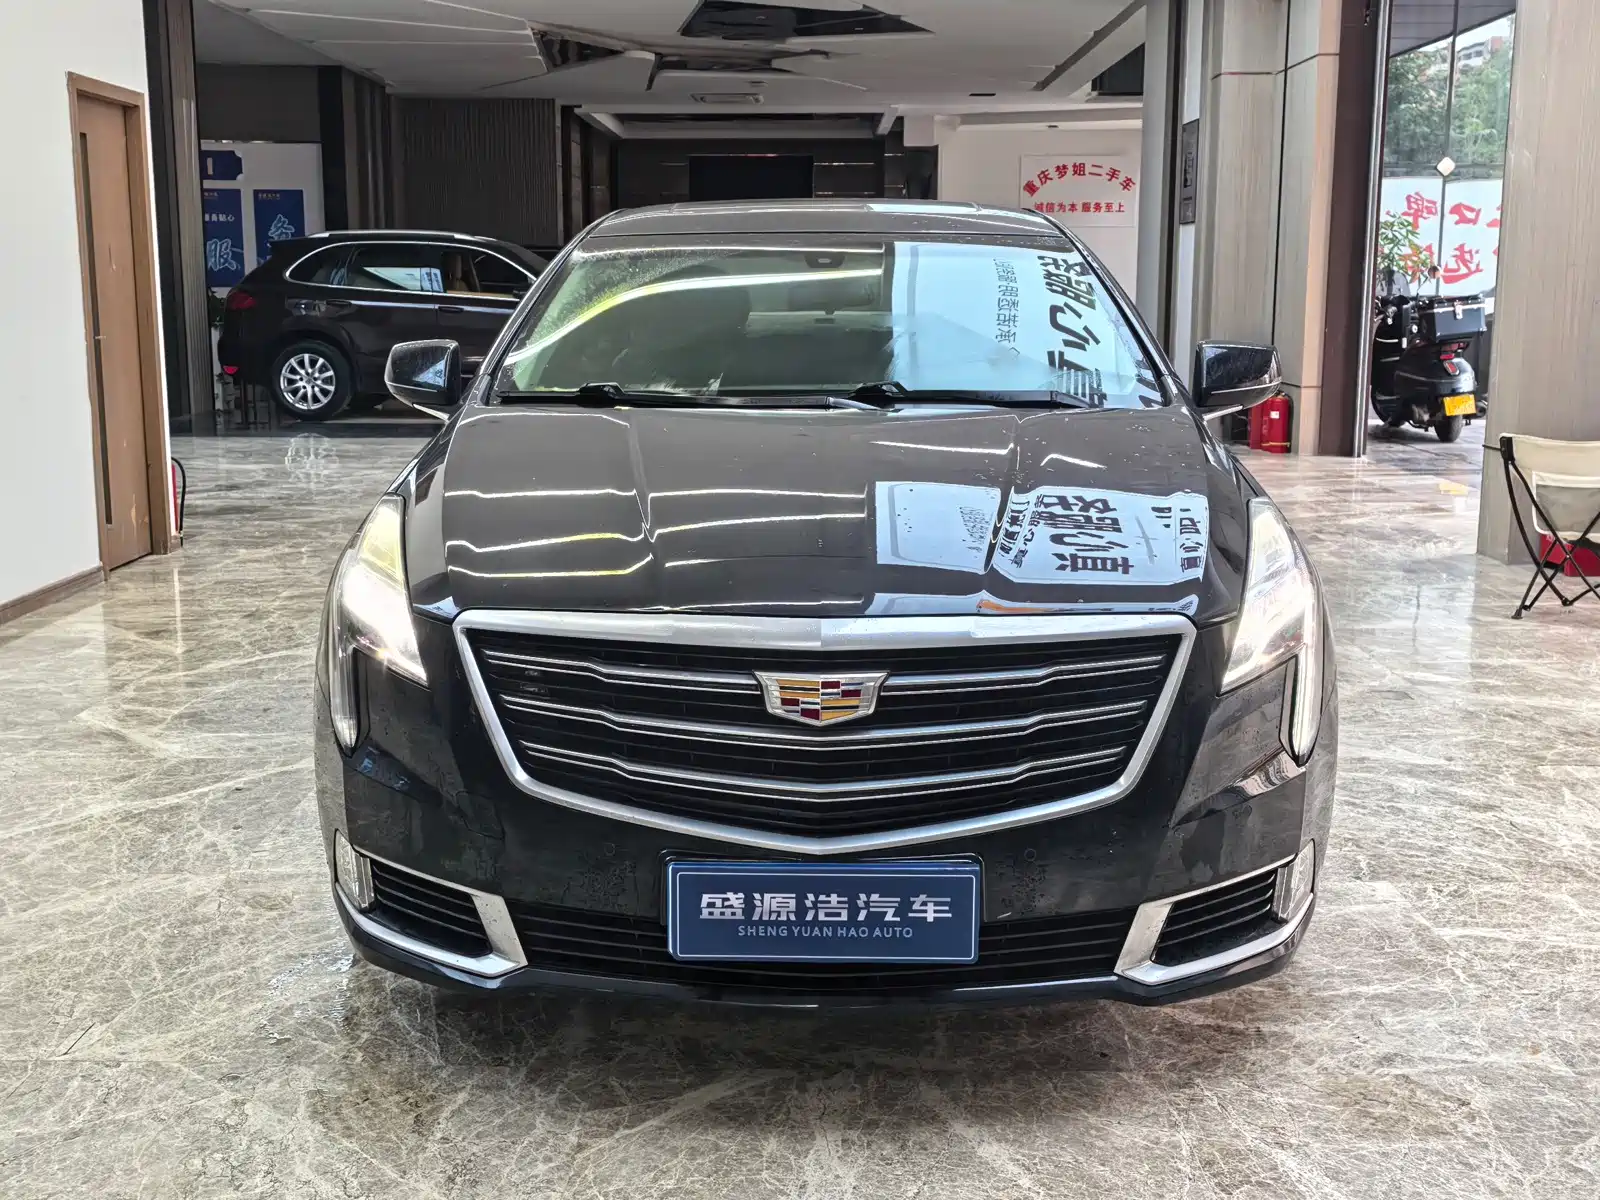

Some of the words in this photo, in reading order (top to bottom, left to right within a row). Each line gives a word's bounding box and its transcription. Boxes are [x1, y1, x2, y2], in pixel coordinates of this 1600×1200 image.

[1022, 162, 1136, 197] 重庆梦姐二手车
[1081, 202, 1125, 213] 服务至上
[699, 892, 952, 922] 盛源浩汽车
[738, 925, 788, 937] SHENG
[791, 925, 833, 937] YUAN
[837, 926, 868, 938] HAO
[872, 926, 913, 938] AUTO
